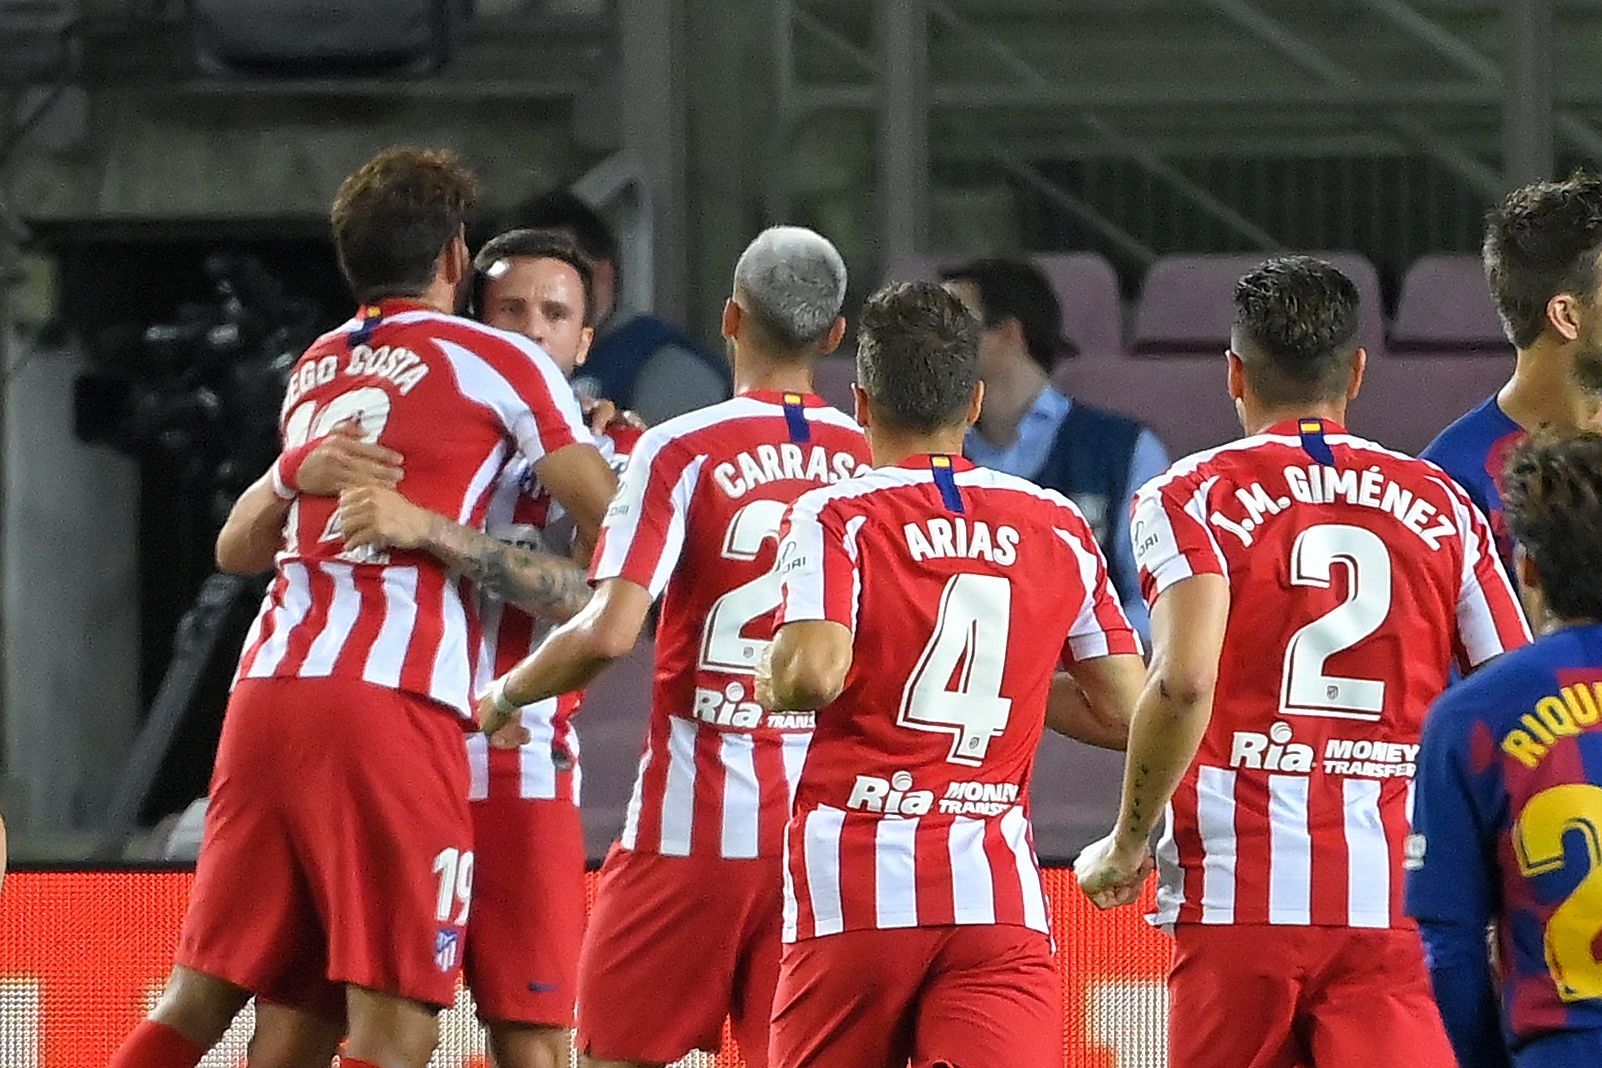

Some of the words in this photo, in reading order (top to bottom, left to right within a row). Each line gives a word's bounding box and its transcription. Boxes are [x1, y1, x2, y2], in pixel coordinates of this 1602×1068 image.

[284, 354, 339, 412] EGO
[344, 344, 430, 397] COSTA
[1210, 482, 1291, 548] J.M.
[1283, 464, 1457, 551] GIMÉNEZ
[903, 517, 1020, 566] ARIAS
[1278, 523, 1392, 722] 2
[896, 573, 1012, 767] 4
[693, 681, 763, 728] Ria
[1229, 721, 1314, 773] Ria
[1324, 739, 1420, 762] MONEY
[846, 770, 934, 816] Ria
